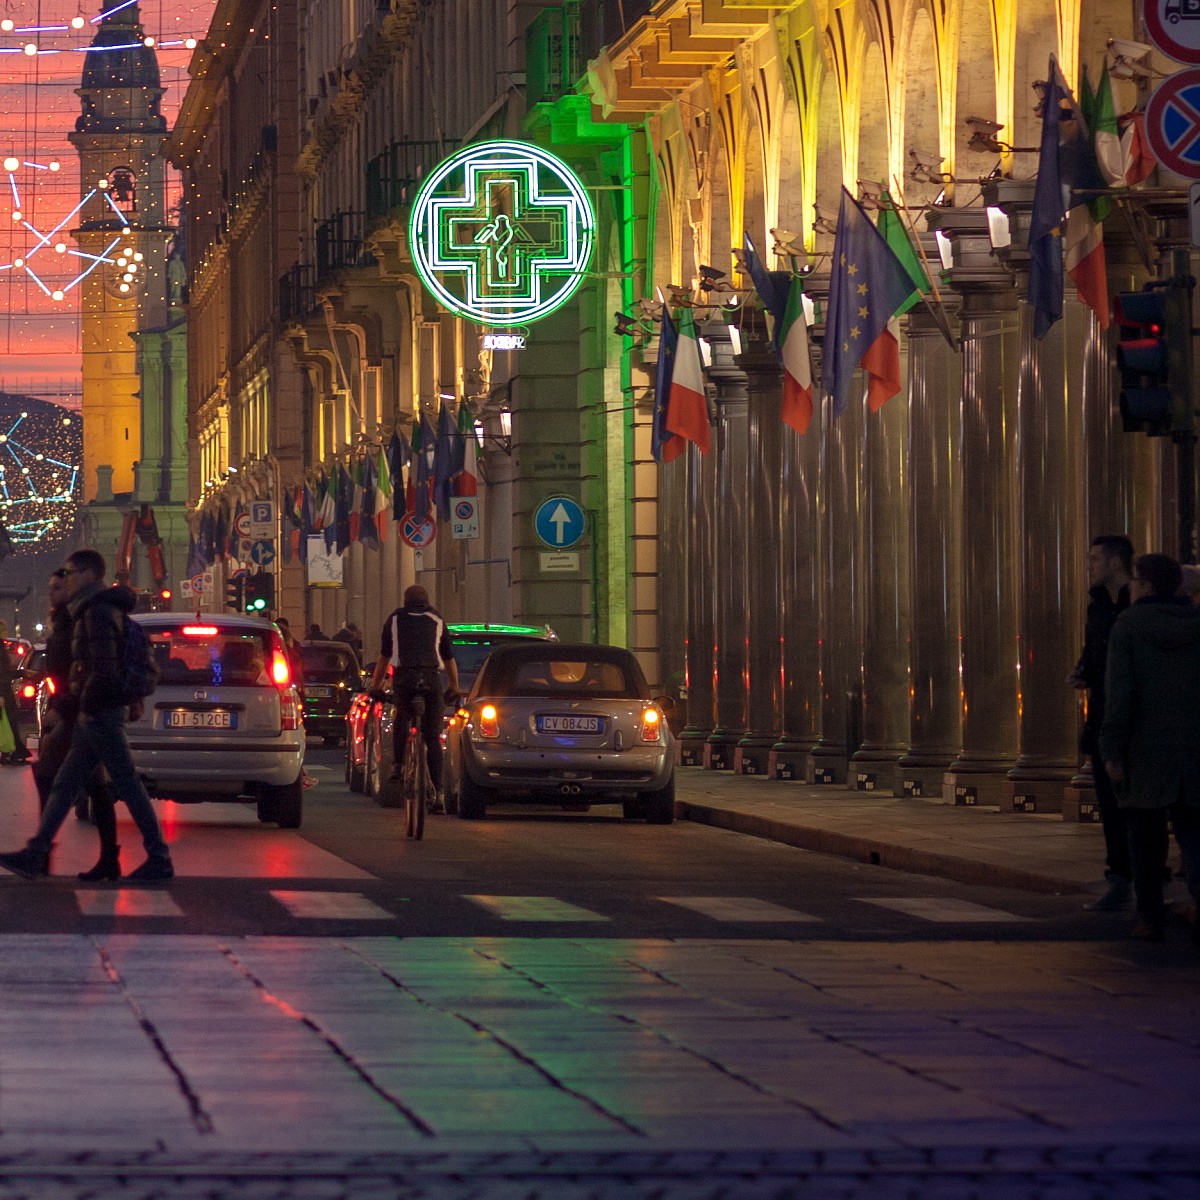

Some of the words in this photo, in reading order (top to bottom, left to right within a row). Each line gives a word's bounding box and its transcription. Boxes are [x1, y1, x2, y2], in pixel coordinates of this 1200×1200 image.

[173, 713, 187, 725] DT
[192, 713, 229, 726] 512CE
[545, 718, 558, 729] CV
[562, 718, 596, 730] 084JS
[965, 796, 975, 804] 12
